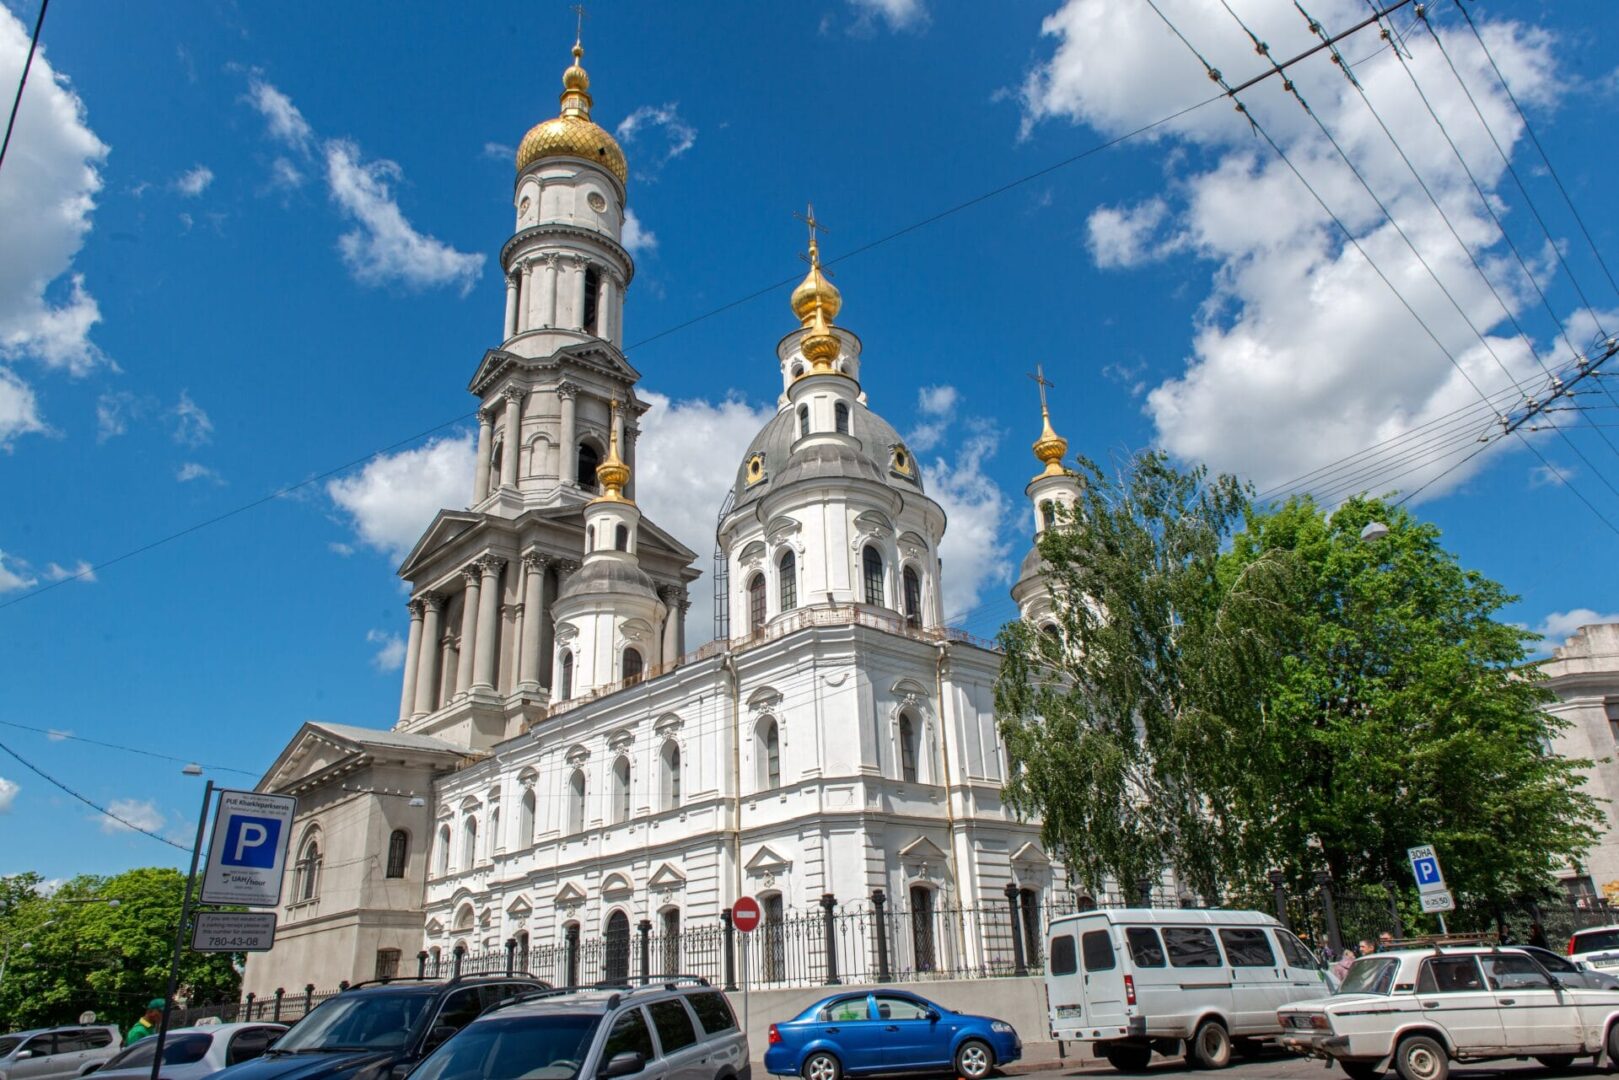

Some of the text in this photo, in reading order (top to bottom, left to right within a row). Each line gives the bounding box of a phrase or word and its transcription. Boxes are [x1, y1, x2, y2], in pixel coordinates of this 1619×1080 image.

[234, 822, 267, 861] P
[1410, 848, 1433, 859] ЗОНА
[1420, 862, 1433, 881] P
[208, 937, 259, 946] 780-43-08
